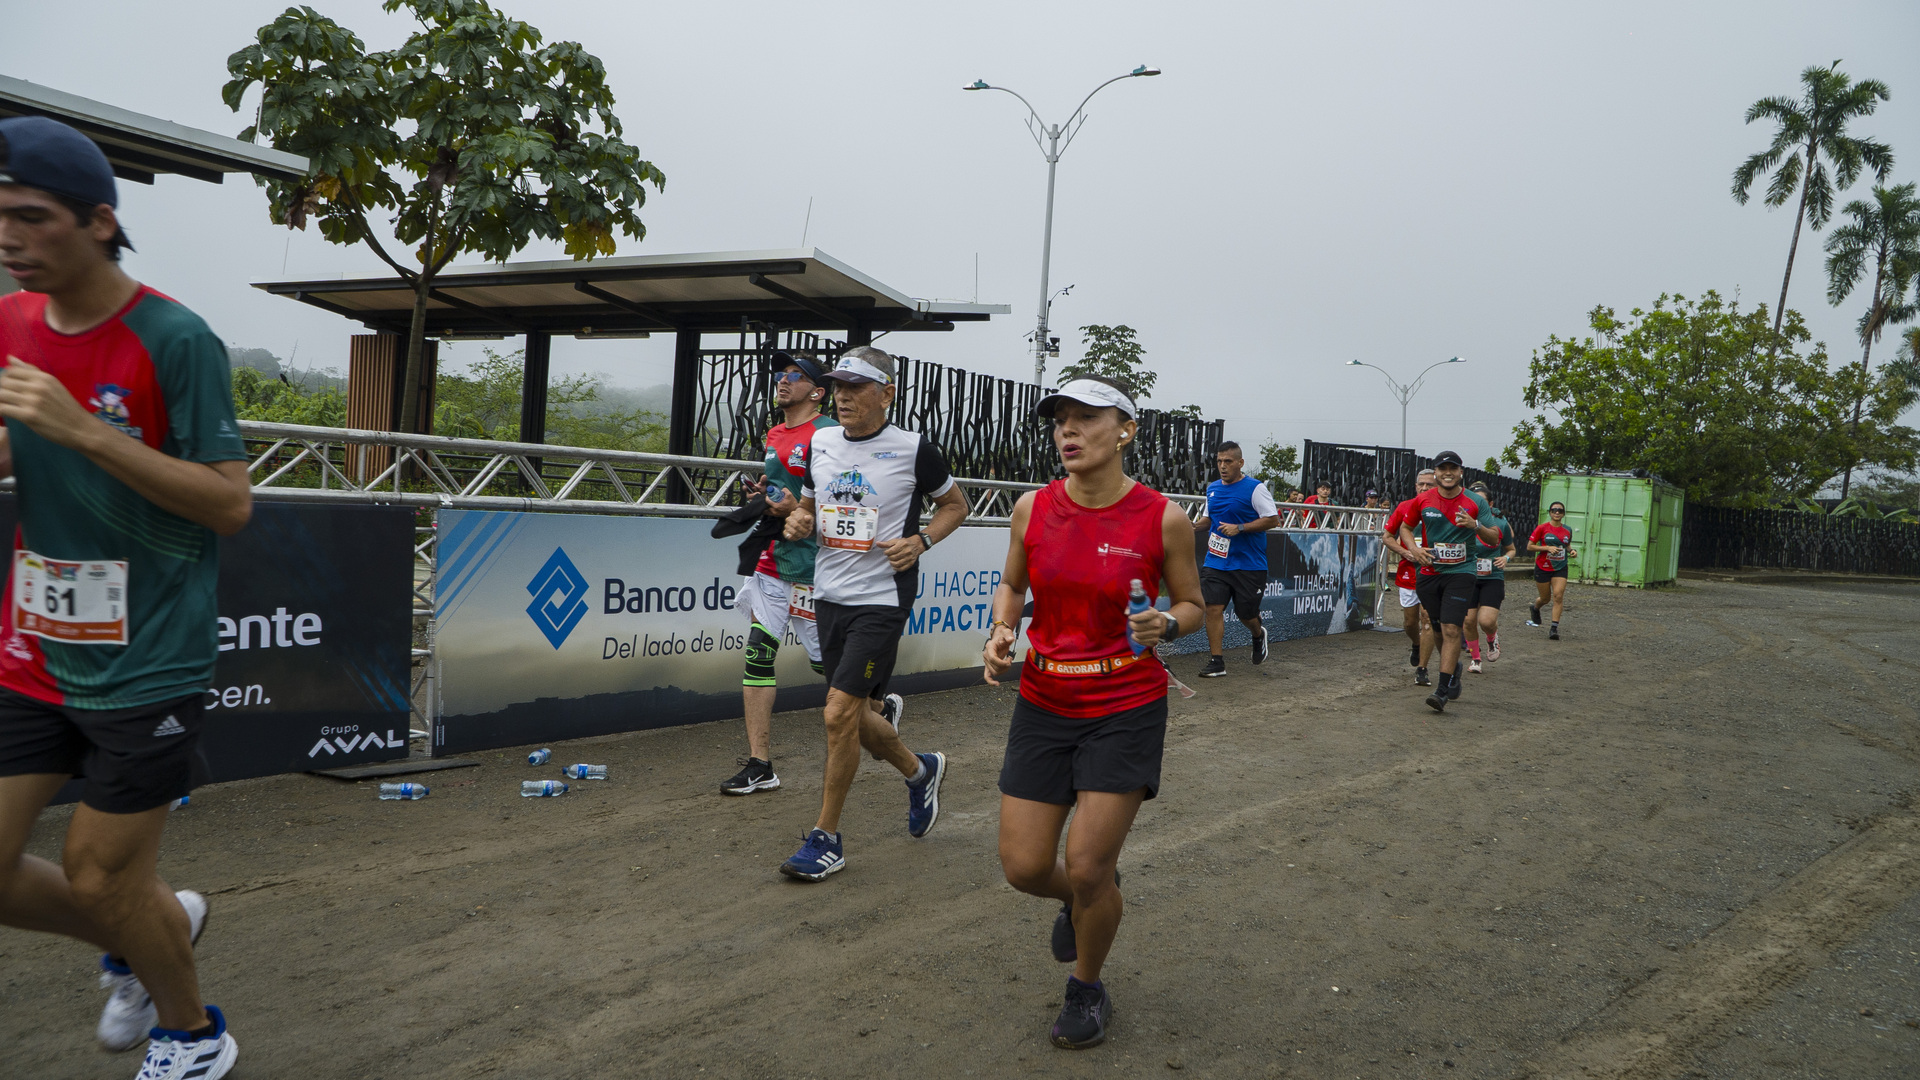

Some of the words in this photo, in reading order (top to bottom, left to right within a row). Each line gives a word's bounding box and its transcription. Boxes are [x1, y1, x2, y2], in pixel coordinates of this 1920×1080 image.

[828, 481, 870, 495] Warriors
[836, 520, 855, 536] 55
[1440, 549, 1462, 558] 1652
[1294, 575, 1307, 592] TU
[45, 585, 76, 616] 61
[604, 578, 696, 615] Banco
[704, 577, 736, 611] de
[1293, 595, 1336, 615] IMPACTA.
[901, 604, 993, 636] MPACT
[602, 634, 638, 660] Del
[643, 632, 687, 657] lado
[691, 630, 714, 652] de
[719, 629, 744, 651] los
[1057, 663, 1106, 674] GATORAD
[321, 724, 359, 736] Grupo
[308, 729, 404, 759] AVAL
